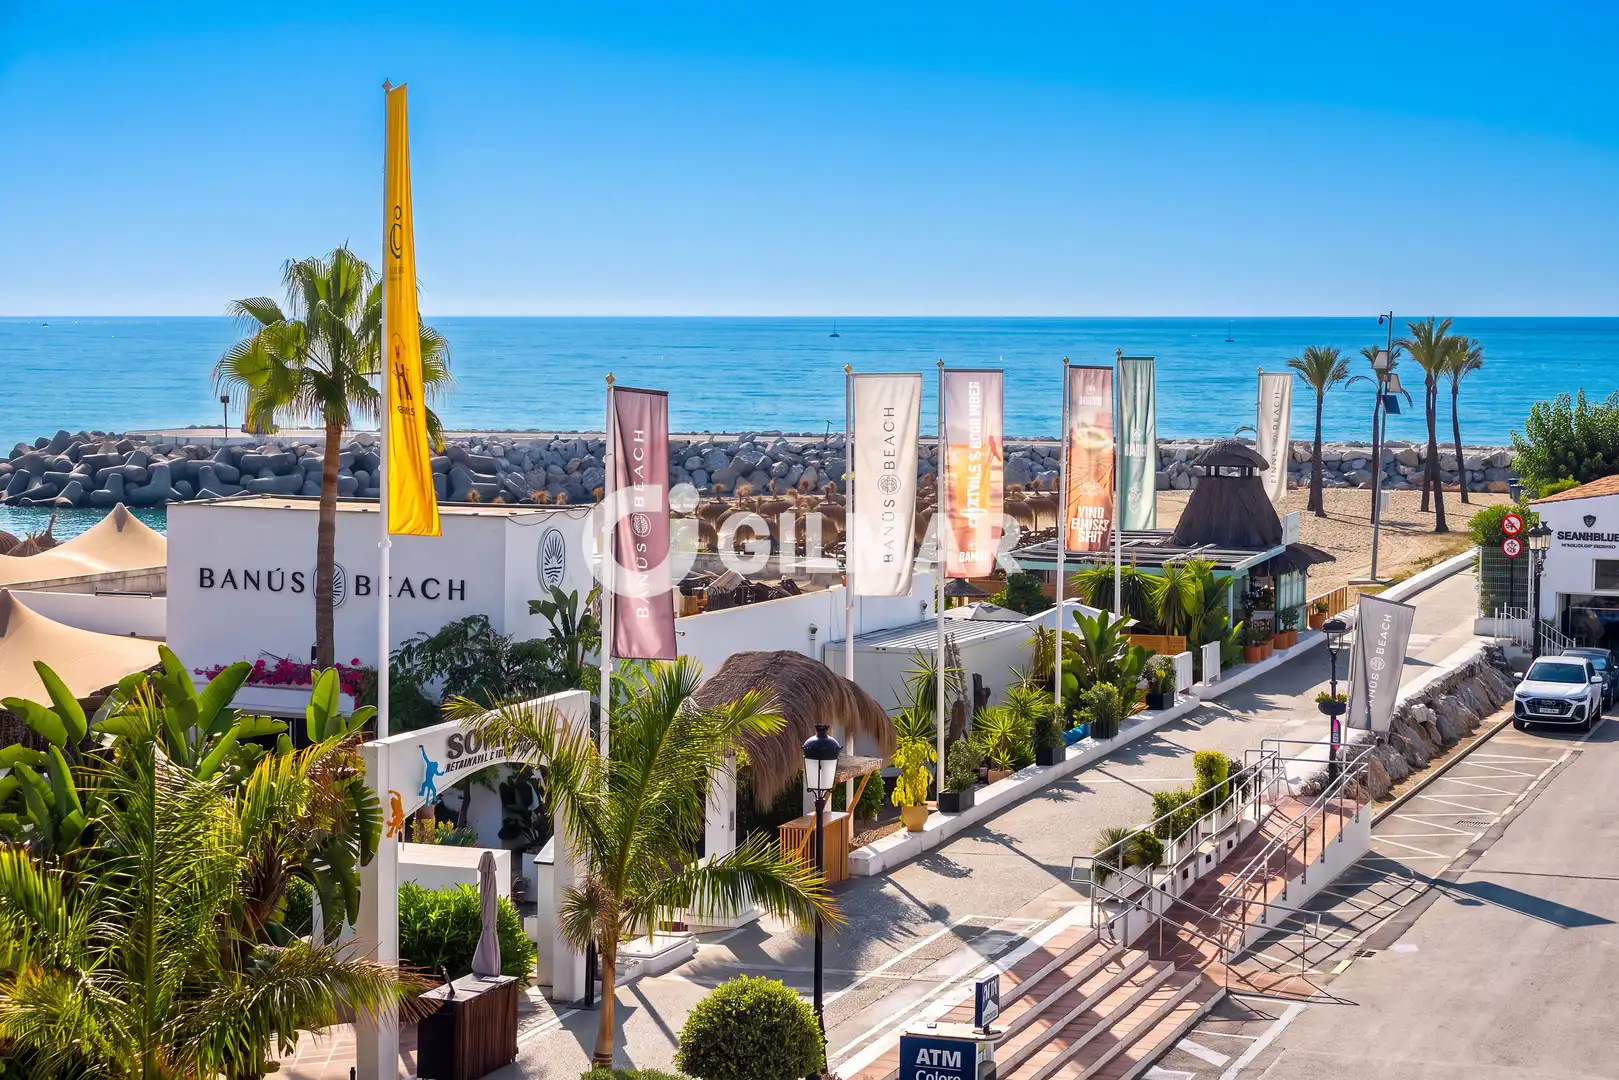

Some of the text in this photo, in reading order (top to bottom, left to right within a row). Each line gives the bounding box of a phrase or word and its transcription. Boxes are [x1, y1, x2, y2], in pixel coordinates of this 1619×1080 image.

[883, 406, 896, 470] BEACH
[633, 429, 645, 507] BEACH
[199, 567, 305, 593] BANÚS
[1375, 614, 1392, 655] BEACH
[915, 1048, 962, 1068] ATM
